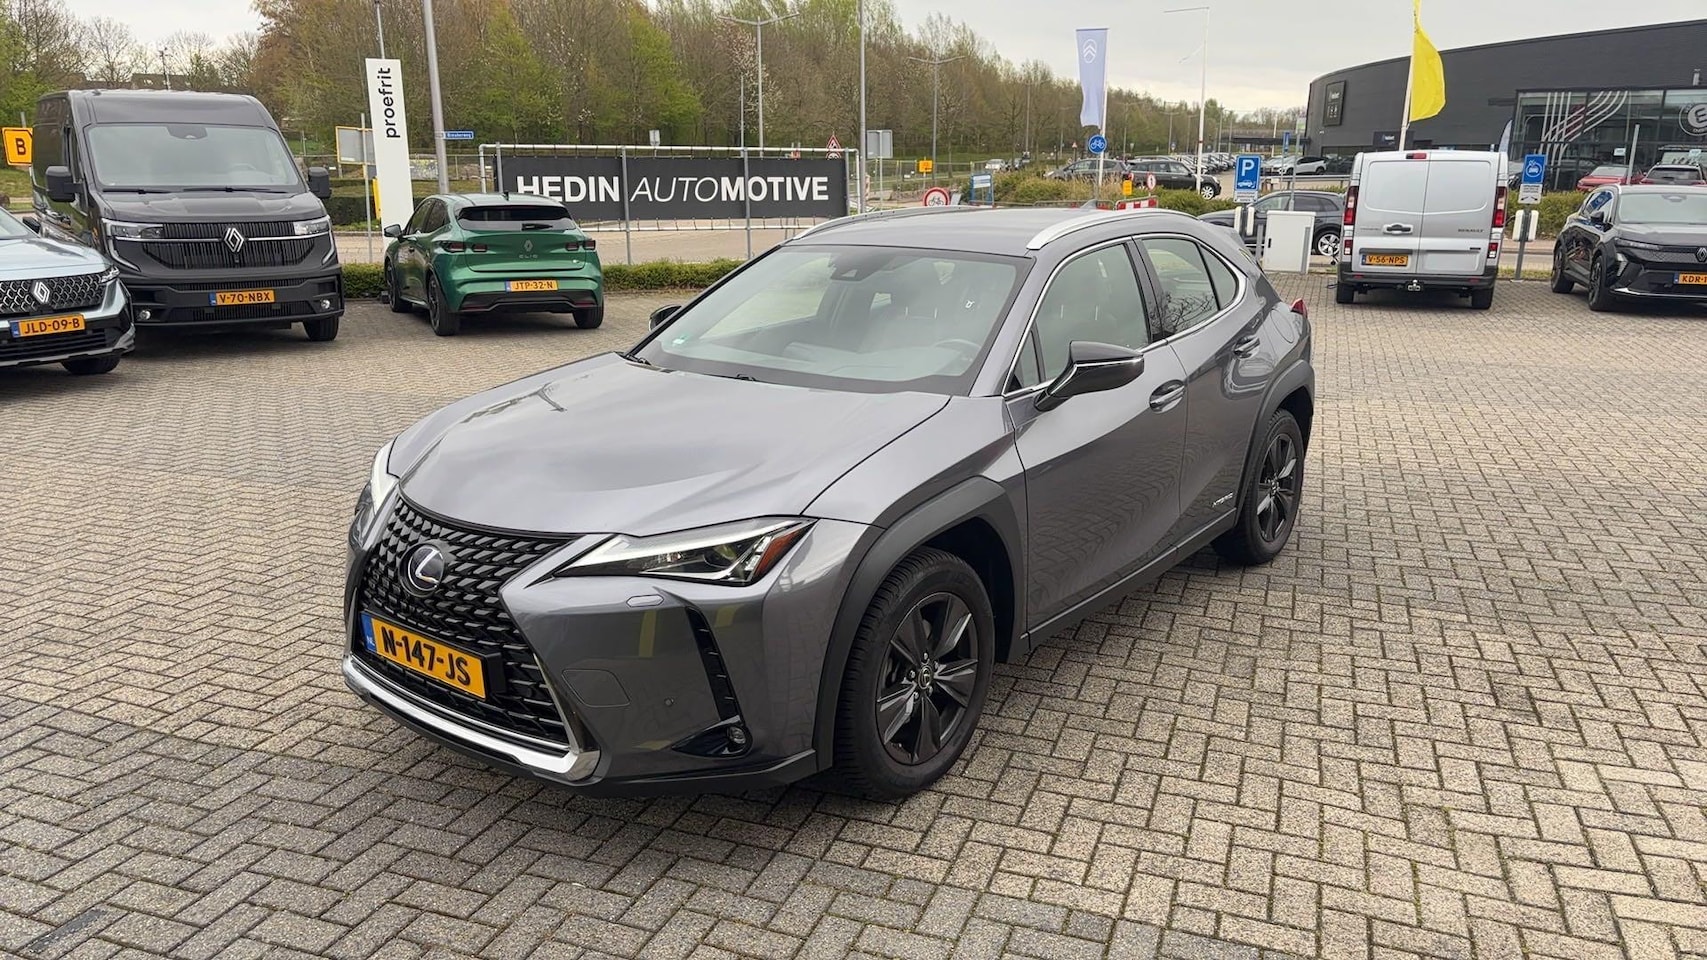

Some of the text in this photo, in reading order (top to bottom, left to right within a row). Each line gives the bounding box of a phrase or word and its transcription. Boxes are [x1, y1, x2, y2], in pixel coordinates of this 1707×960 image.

[377, 67, 401, 138] proefrit
[15, 137, 26, 155] B
[1241, 159, 1255, 176] P
[516, 176, 829, 202] HEDIN AUTOMOTIVE
[1368, 255, 1405, 264] V-56-NPS
[515, 281, 553, 290] JTP-32-N
[219, 292, 271, 303] V-70-NBX
[25, 318, 80, 334] JLD-09-B
[381, 626, 471, 686] N-147-JS
